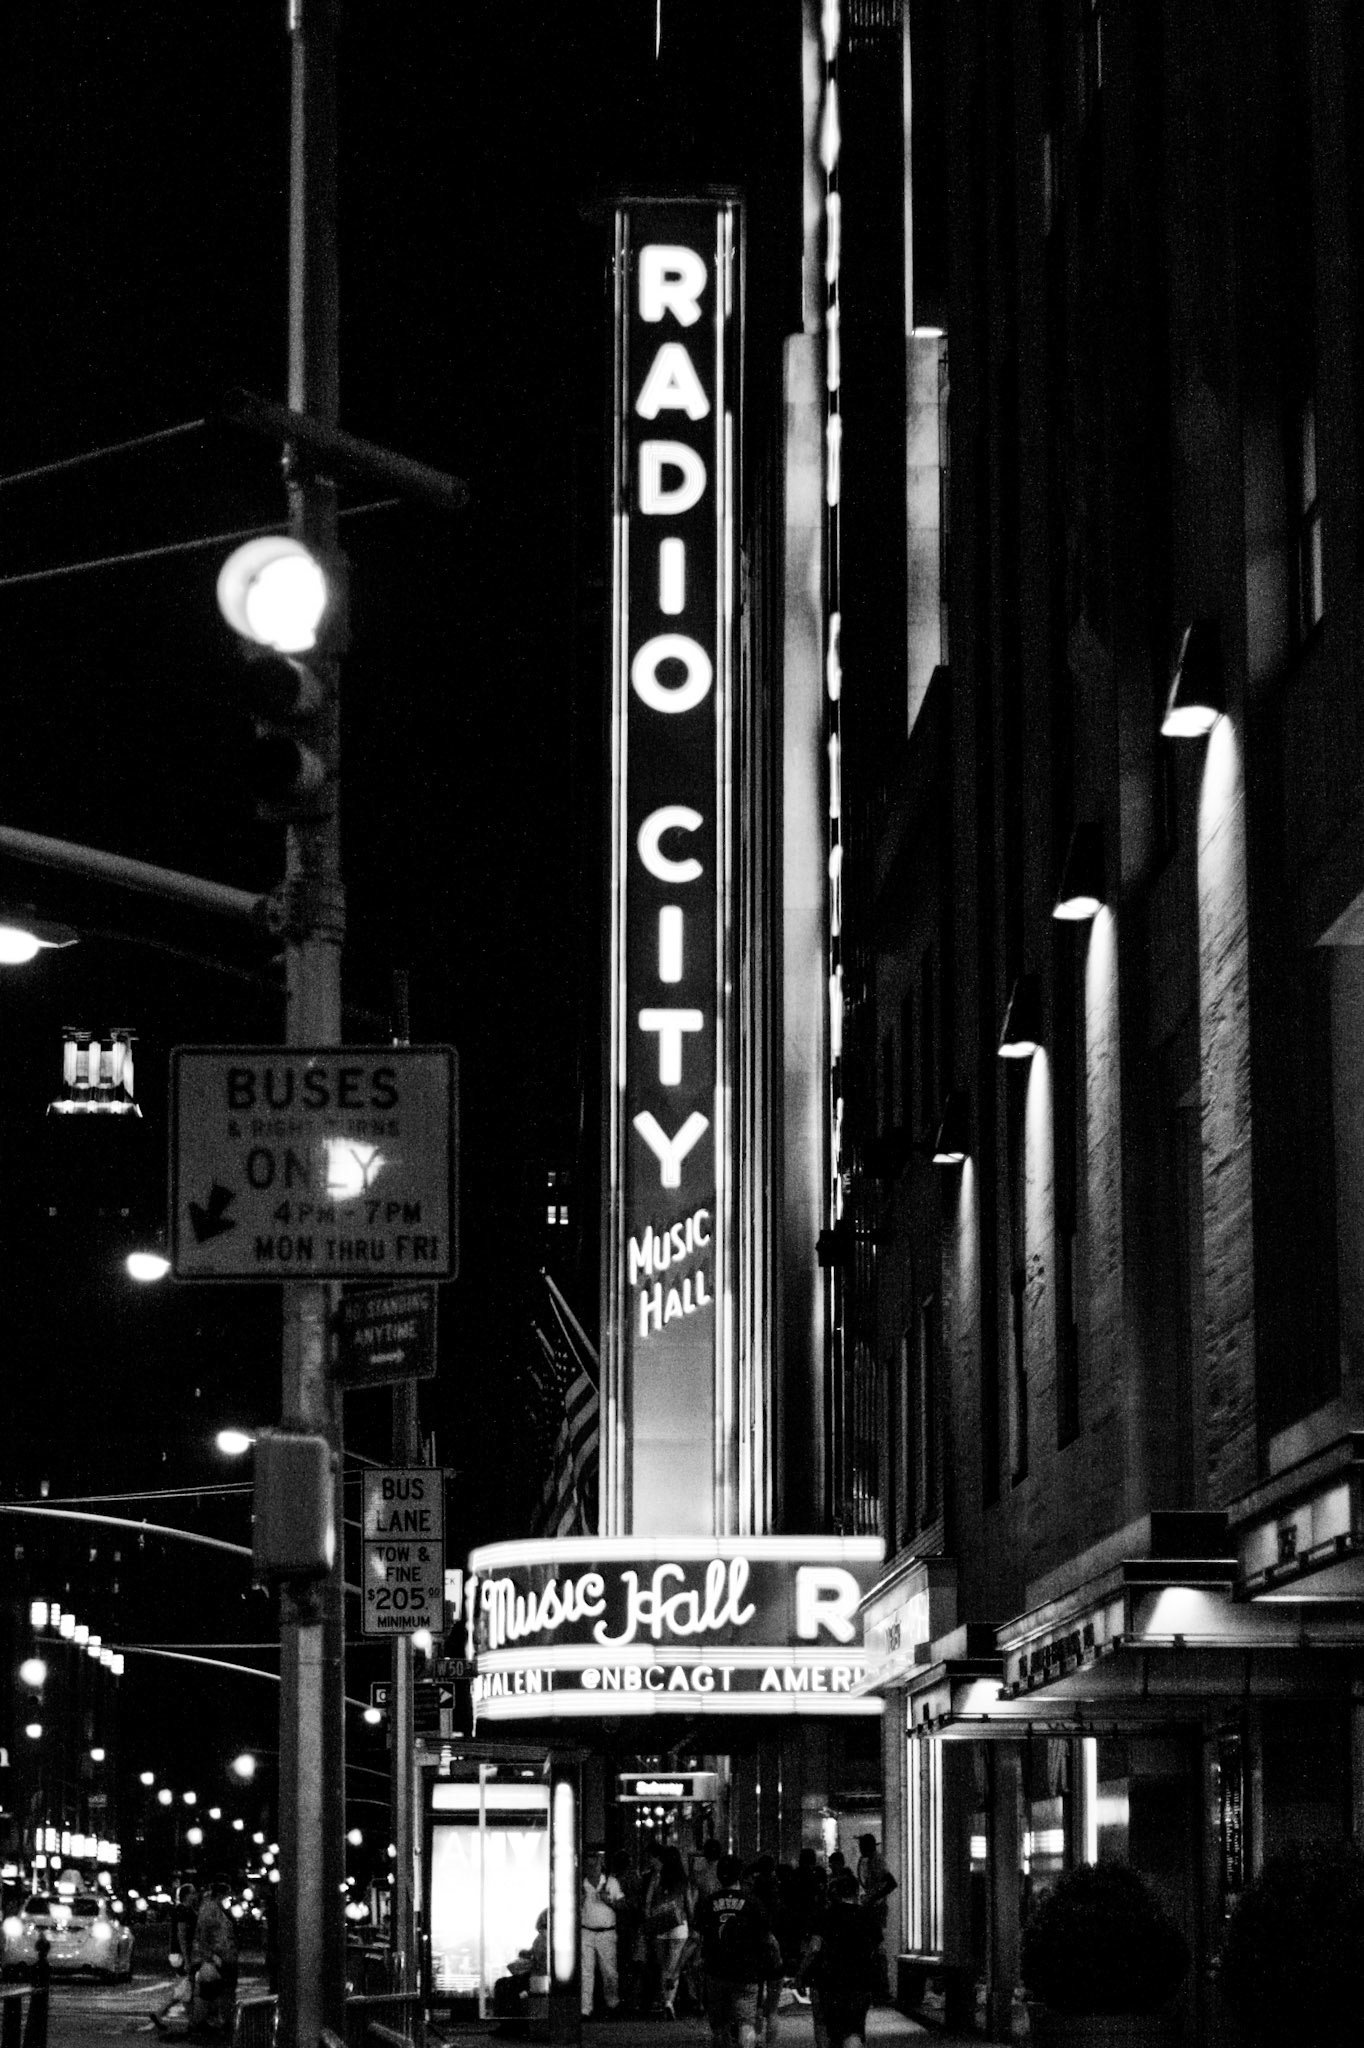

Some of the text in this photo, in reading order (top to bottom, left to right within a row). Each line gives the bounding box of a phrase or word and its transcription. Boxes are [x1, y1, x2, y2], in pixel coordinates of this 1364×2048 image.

[631, 244, 712, 714] RADIO
[633, 805, 709, 1188] CITY
[227, 1067, 400, 1109] BUSES
[248, 1147, 382, 1190] ONLY
[255, 1235, 439, 1261] MON THRU FRI
[628, 1208, 711, 1285] MUSIC
[640, 1270, 711, 1337] HALL
[381, 1477, 424, 1501] BUS
[375, 1509, 431, 1532] LANE
[376, 1546, 431, 1562] TOW &
[386, 1566, 421, 1582] FINE
[378, 1615, 430, 1628] MINIMUM
[482, 1556, 755, 1650] Music Hall
[486, 1667, 556, 1698] TALENT
[581, 1665, 735, 1691] @NBCAGT
